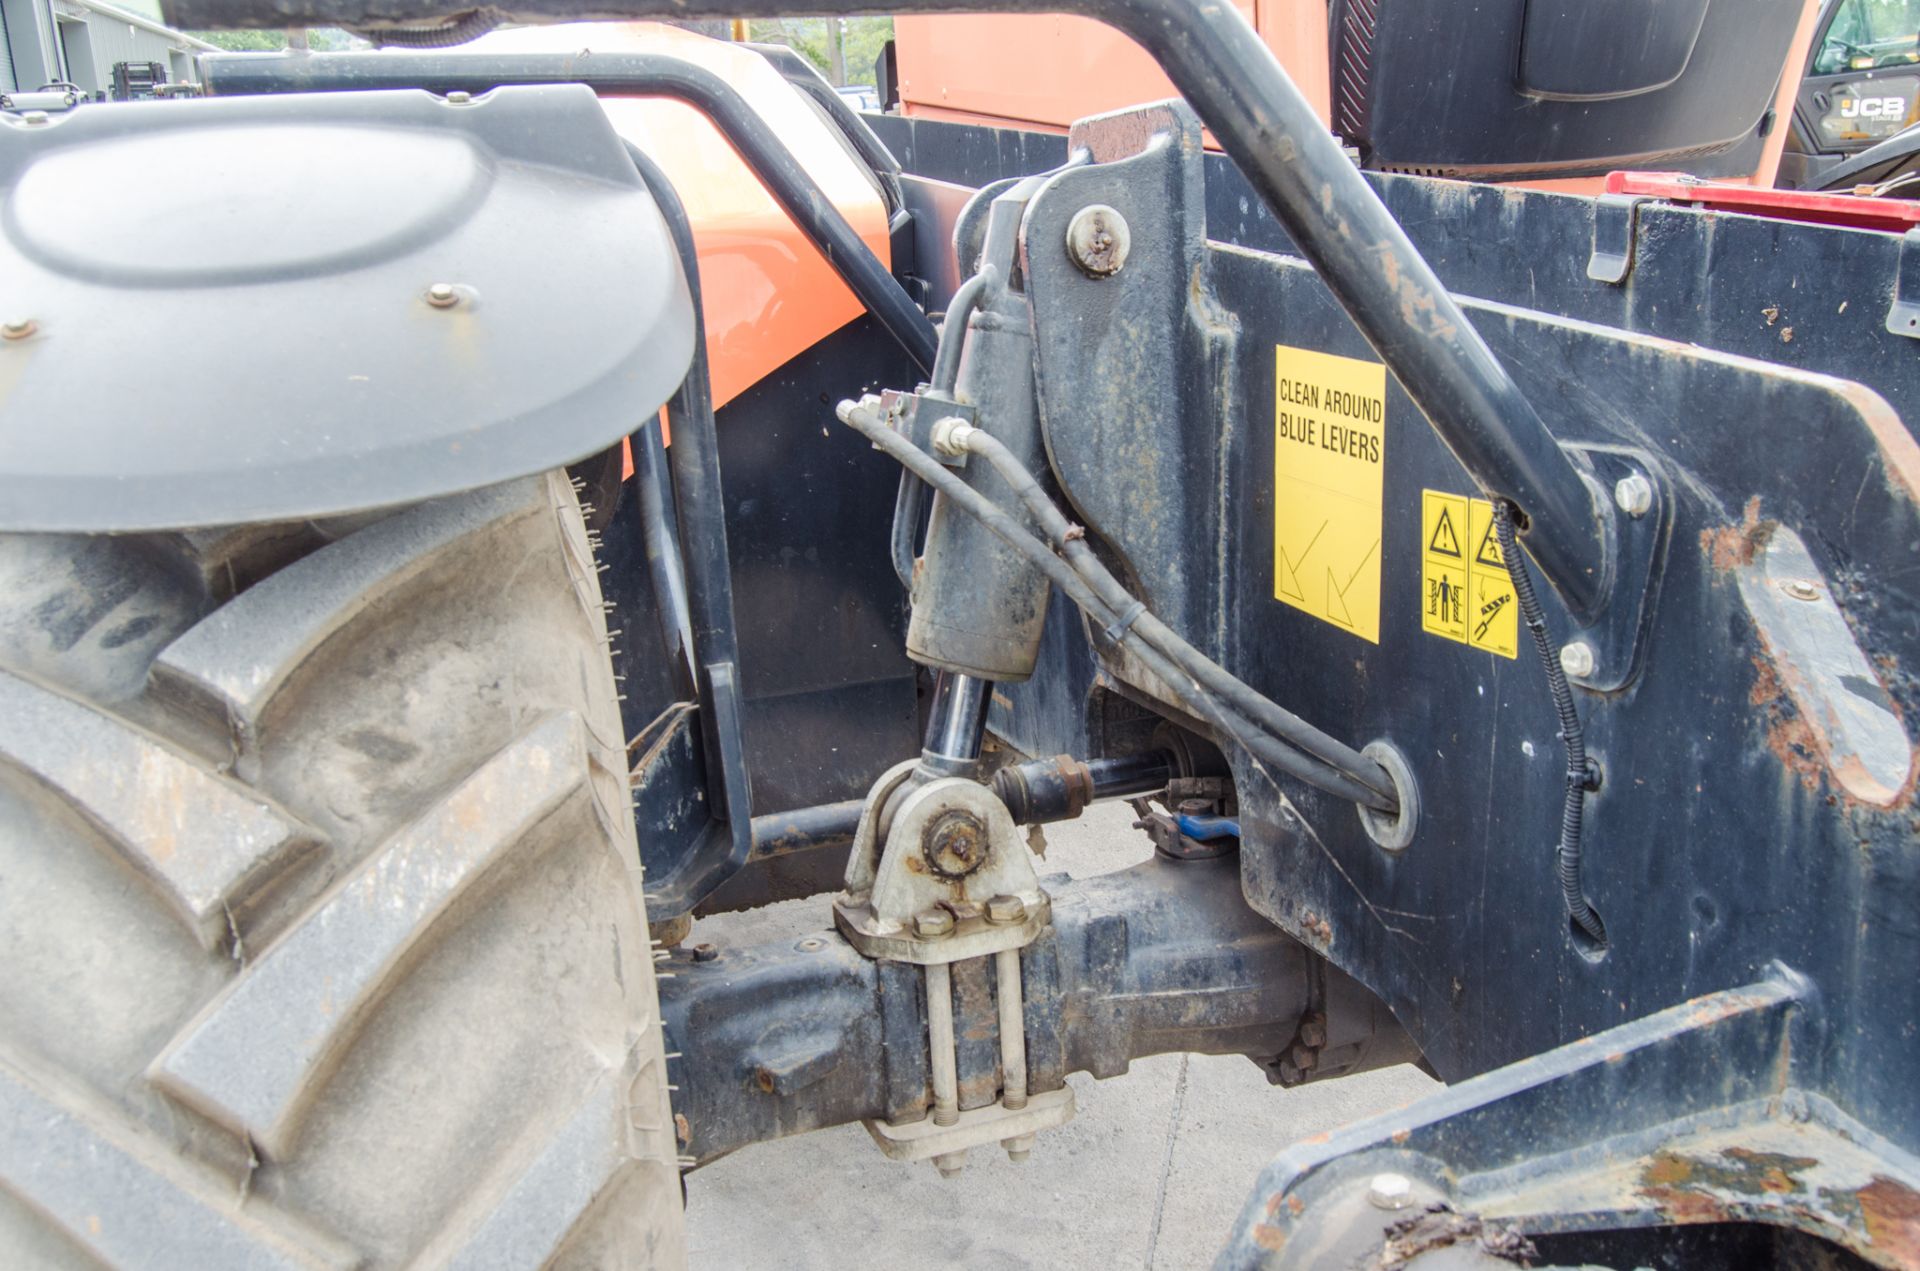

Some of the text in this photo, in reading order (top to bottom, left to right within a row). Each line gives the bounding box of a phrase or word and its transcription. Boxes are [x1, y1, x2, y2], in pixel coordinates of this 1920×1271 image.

[1841, 97, 1905, 118] JCB
[1280, 378, 1382, 424] CLEAN AROUND
[1280, 412, 1380, 464] BLUE LEVERS
